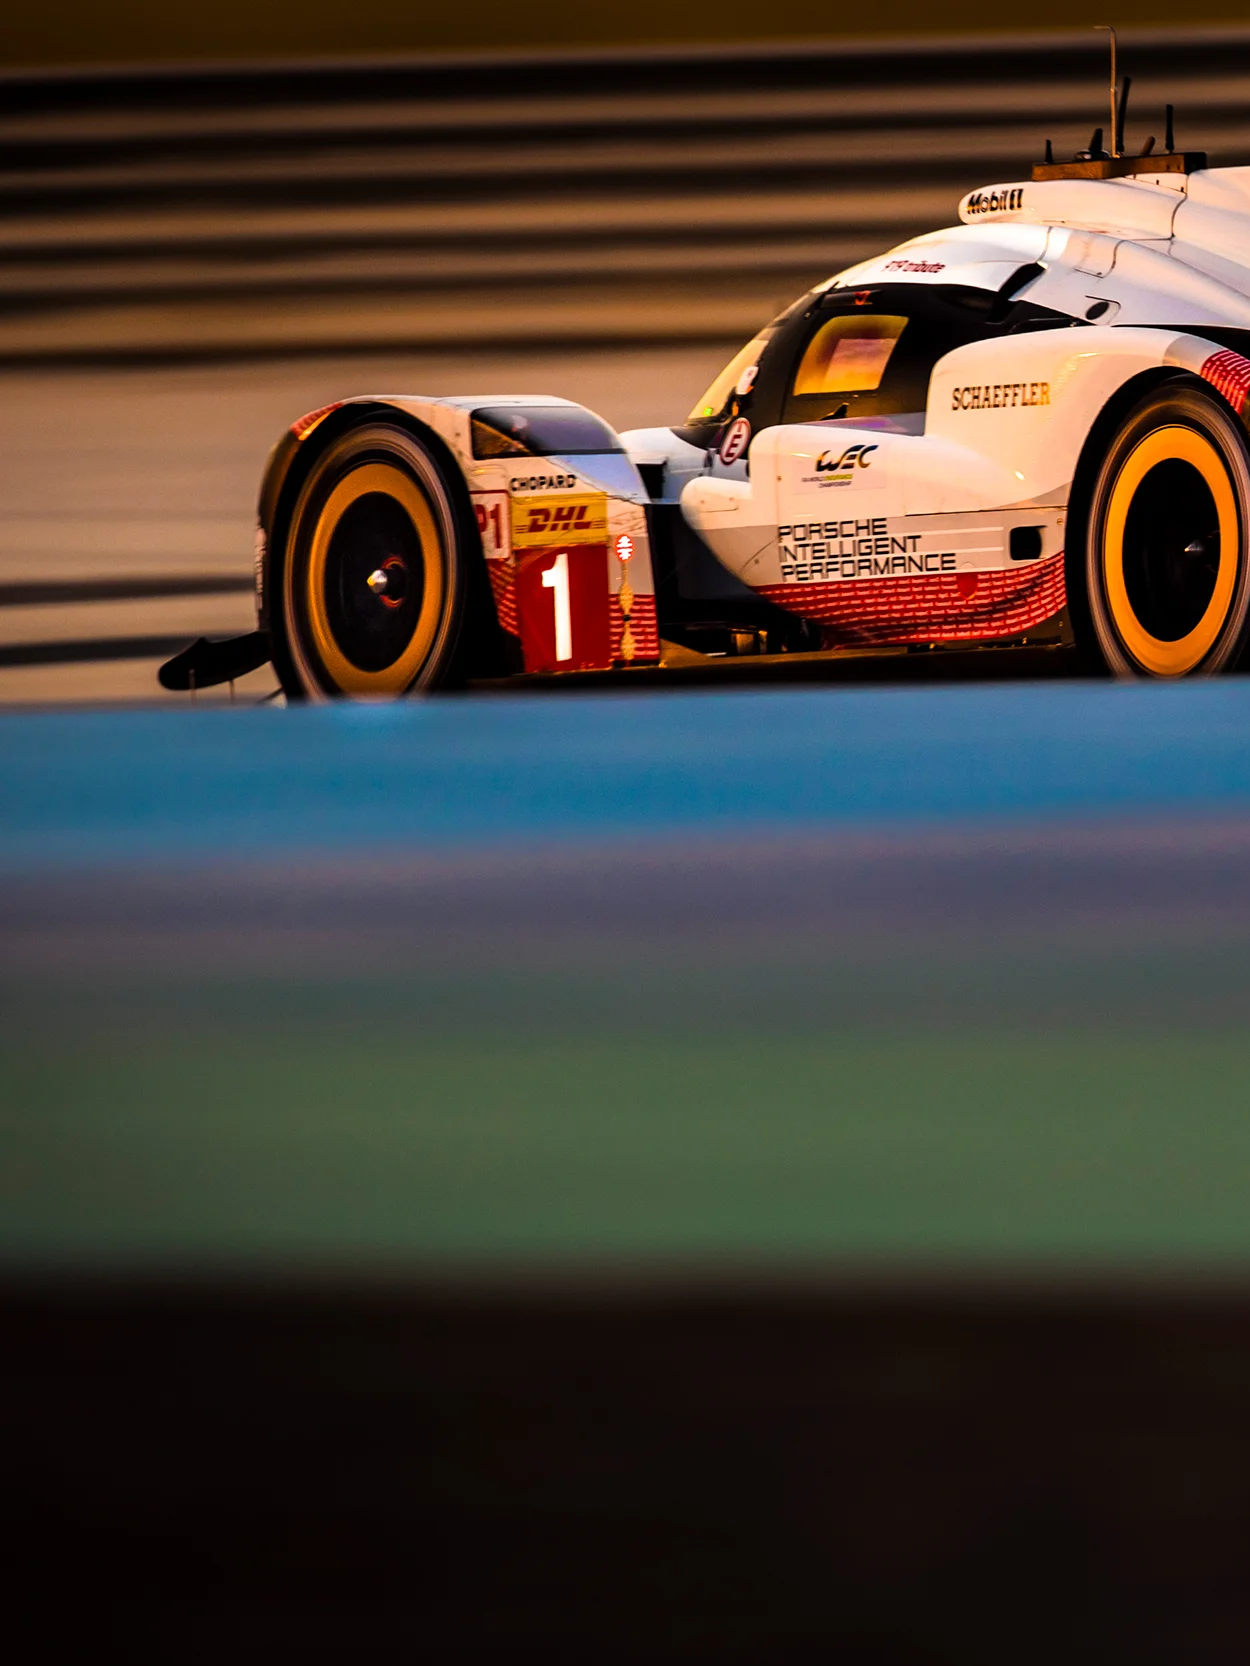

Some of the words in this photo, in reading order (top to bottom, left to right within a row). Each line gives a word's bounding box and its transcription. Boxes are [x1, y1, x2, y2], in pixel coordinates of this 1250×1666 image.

[967, 190, 1009, 214] Mobil
[951, 382, 1050, 411] SCHAEFFLER
[725, 434, 743, 458] E
[815, 444, 880, 472] WEC
[510, 474, 577, 492] CHOPARD
[527, 505, 593, 532] DHL
[778, 518, 888, 543] PORSCHE
[780, 535, 922, 563] INTELLIGENT
[781, 553, 957, 582] PERFORMANCE
[541, 552, 573, 662] 1
